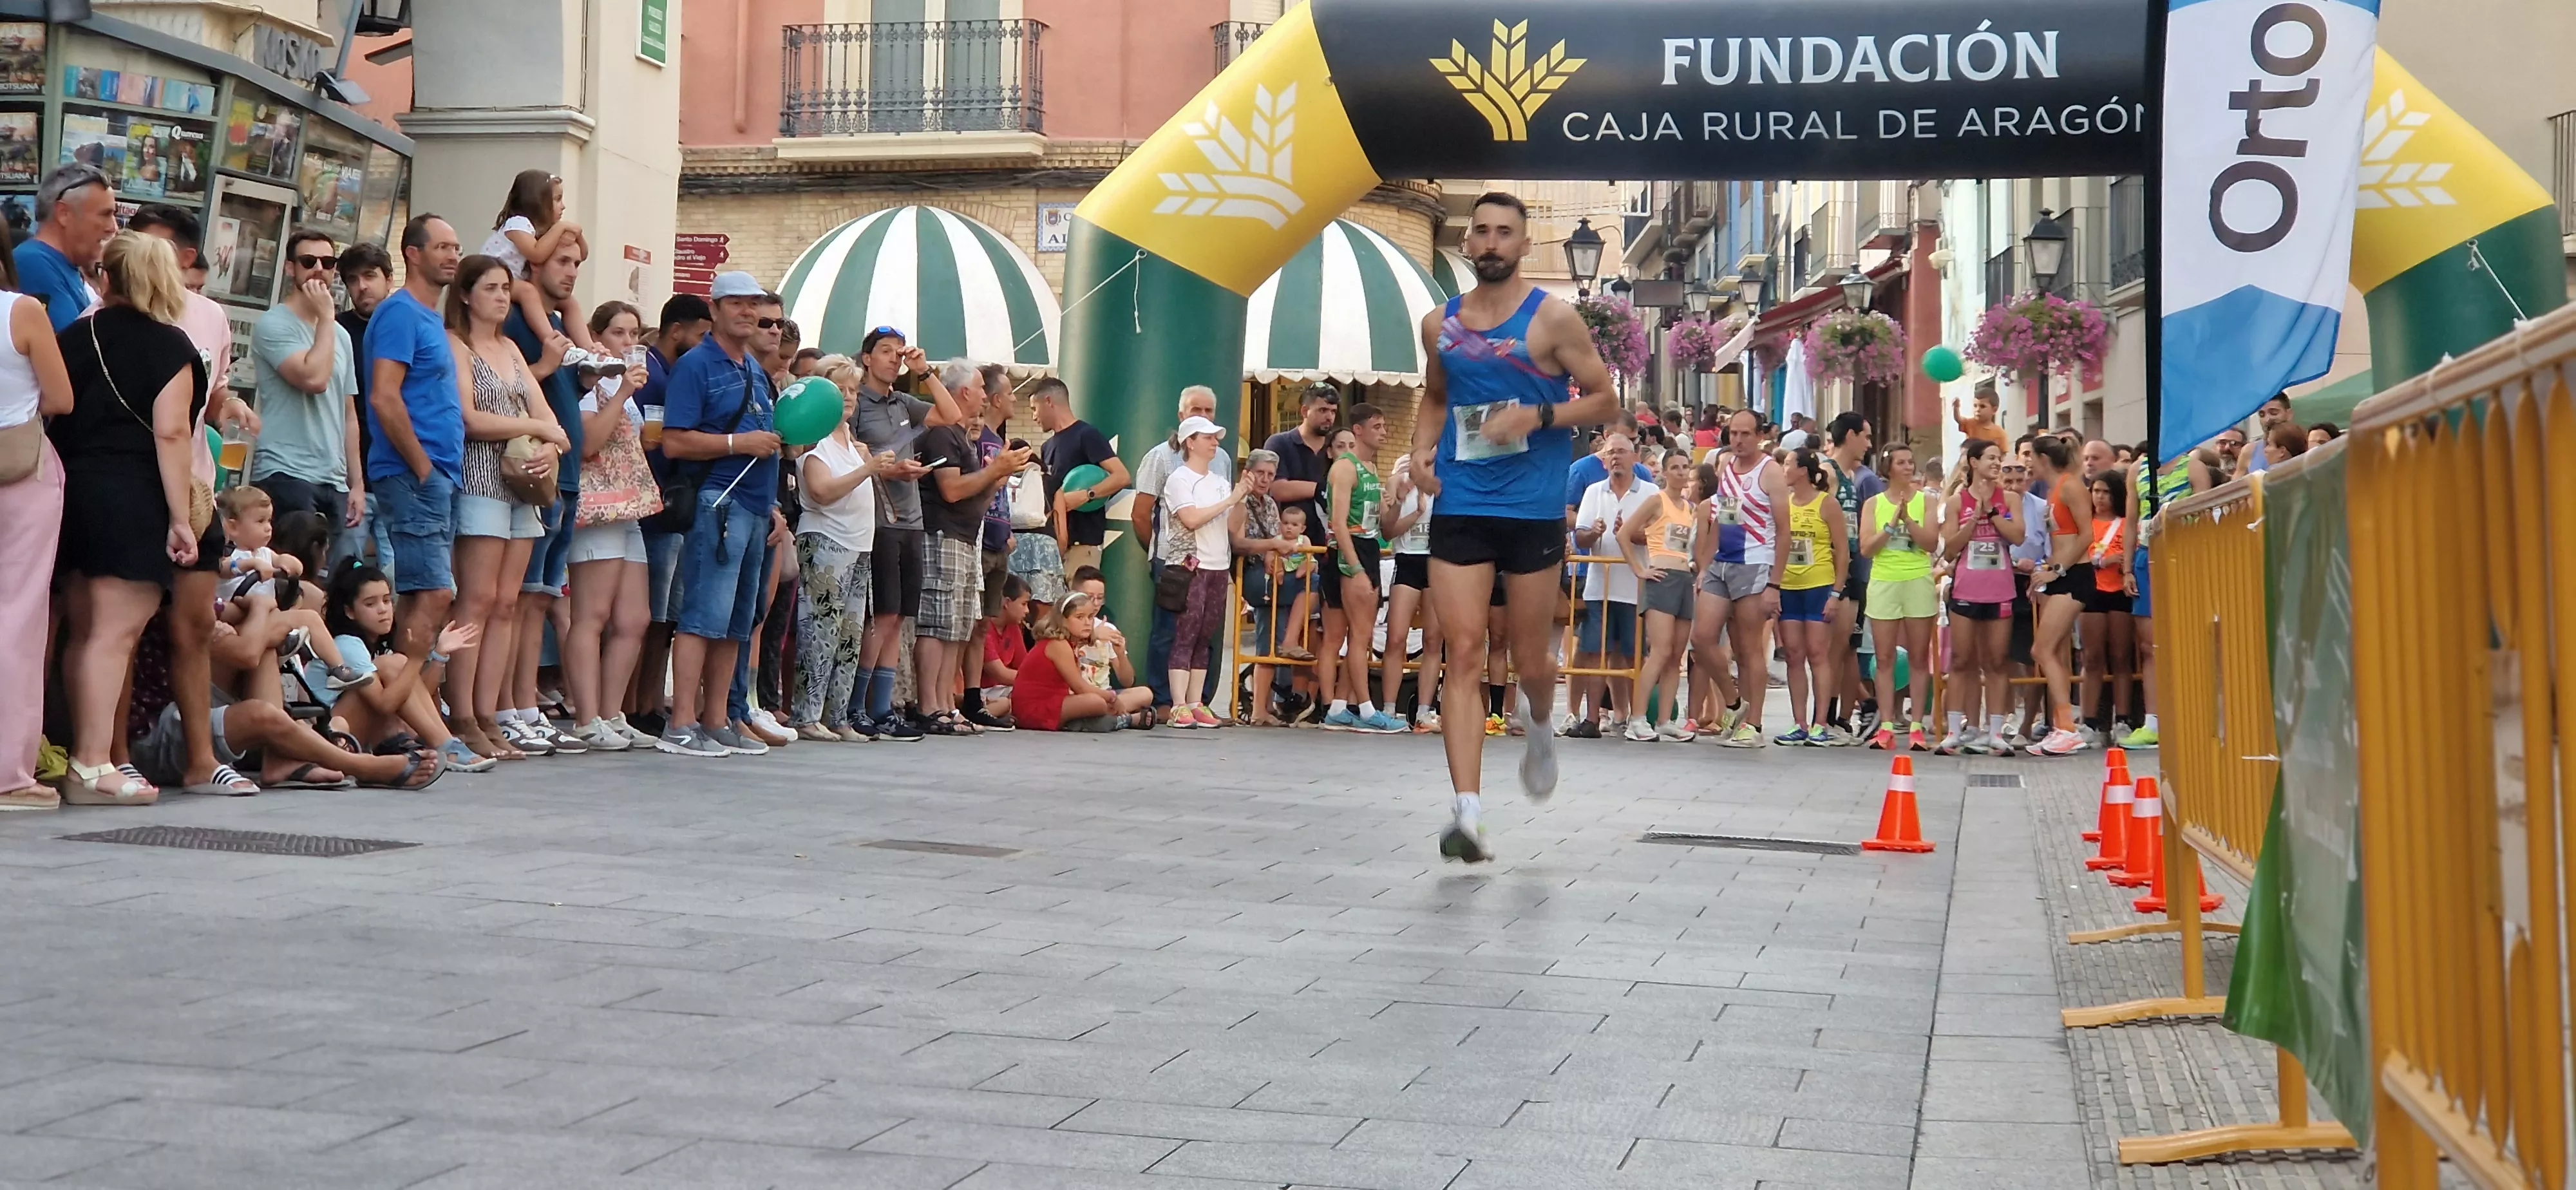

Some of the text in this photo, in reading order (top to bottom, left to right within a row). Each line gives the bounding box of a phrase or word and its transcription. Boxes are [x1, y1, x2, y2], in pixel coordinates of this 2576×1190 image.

[1661, 18, 2060, 86] FUNDACIÓN
[1562, 111, 1683, 142] CAJA
[1703, 111, 1859, 141] RURAL
[1879, 109, 1938, 139] DE
[2208, 2, 2328, 253] Orto
[1676, 525, 1689, 536] 24
[1978, 542, 1996, 552] 25
